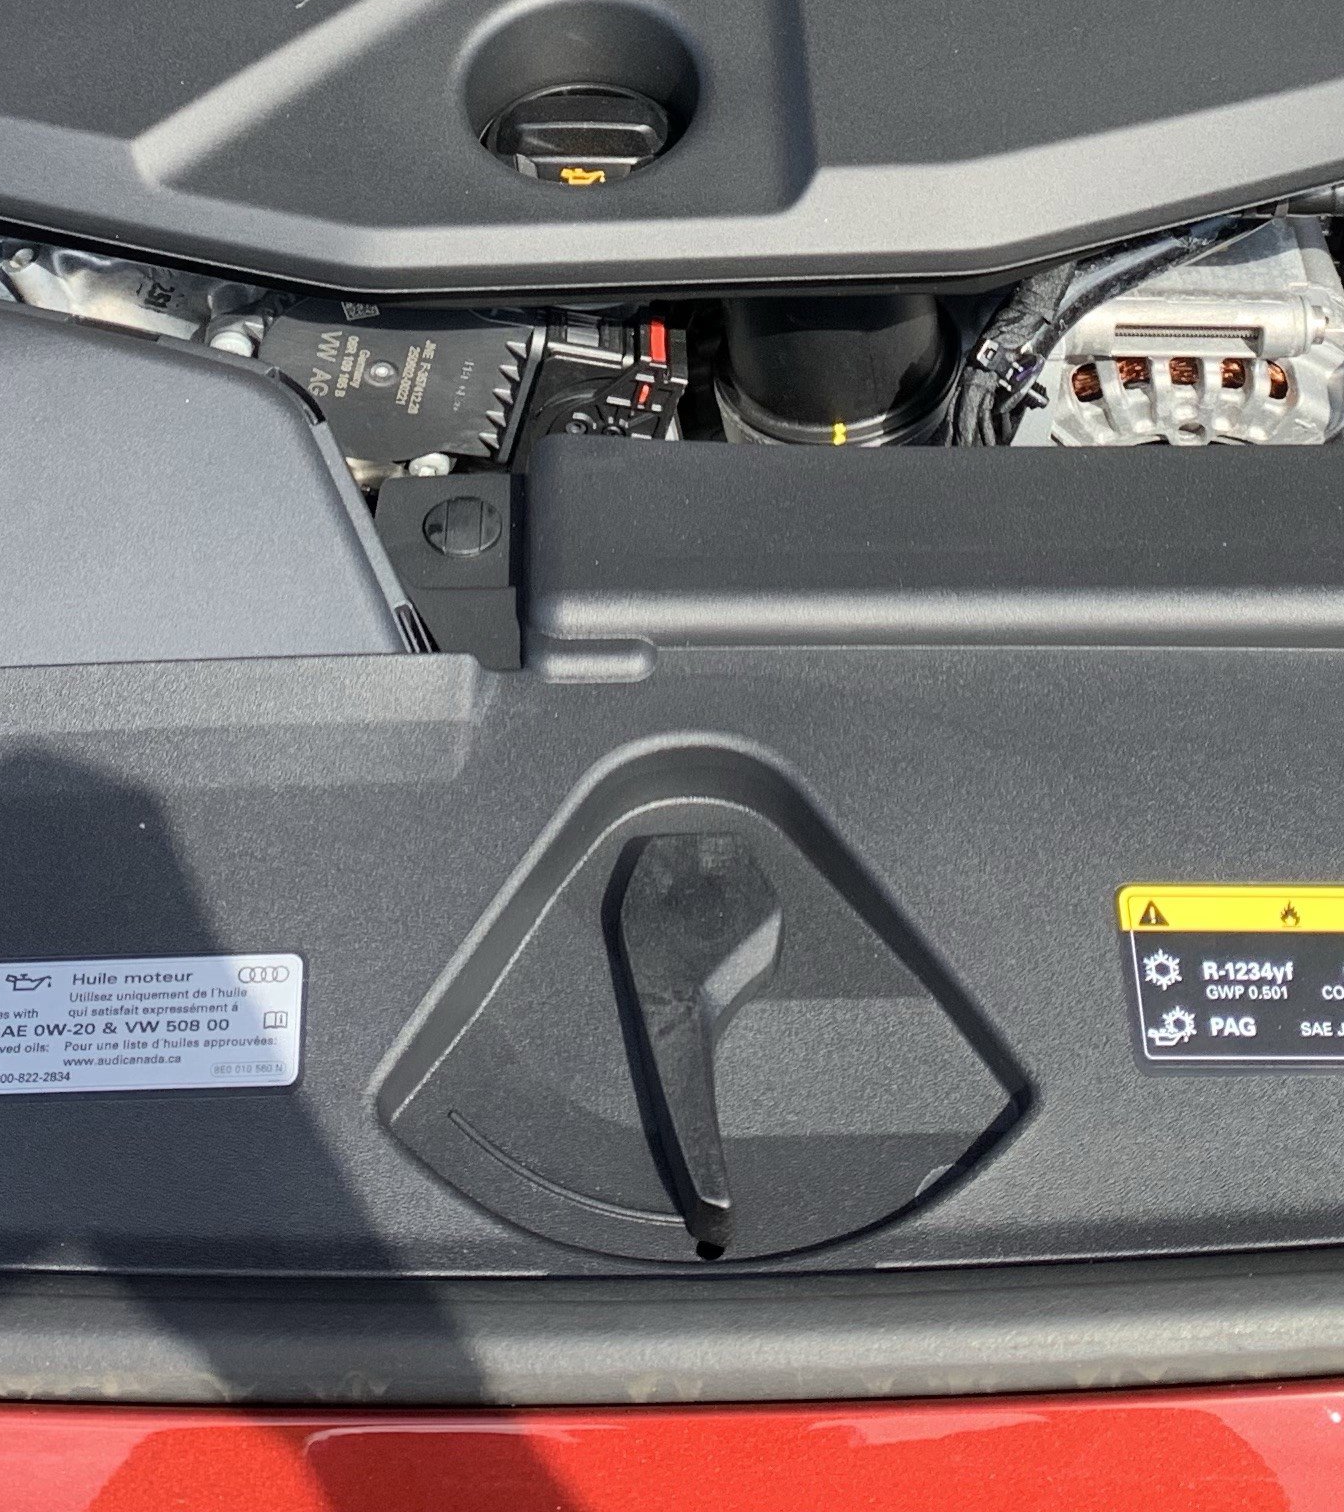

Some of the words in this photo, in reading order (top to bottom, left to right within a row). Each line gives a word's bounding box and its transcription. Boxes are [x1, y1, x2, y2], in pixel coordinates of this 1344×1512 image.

[316, 331, 343, 363] VW
[307, 367, 332, 397] AG
[72, 973, 118, 985] Huile
[124, 973, 193, 983] moteur
[1202, 962, 1295, 985] R-1234yf
[69, 992, 113, 1002] Utilisez
[116, 990, 189, 1002] uniquement
[192, 989, 207, 999] de
[211, 988, 248, 1000] l'huile
[1206, 985, 1245, 999] GWP
[1248, 985, 1288, 1000] 0.501
[13, 1008, 38, 1019] with
[68, 1006, 88, 1019] qui
[91, 1005, 139, 1016] satisfait
[142, 1004, 228, 1016] expressément
[34, 1023, 96, 1036] 0W-20
[102, 1022, 117, 1034] &
[125, 1020, 160, 1033] VW
[166, 1019, 200, 1032] 508
[207, 1019, 229, 1031] 00
[1210, 1016, 1256, 1036] PAG
[1300, 1022, 1333, 1036] SAE
[24, 1042, 49, 1053] oils:
[64, 1041, 93, 1052] Pour
[96, 1042, 119, 1051] une
[123, 1040, 148, 1050] liste
[151, 1038, 199, 1049] d'huiles
[62, 1055, 181, 1066] www.audicanada.ca
